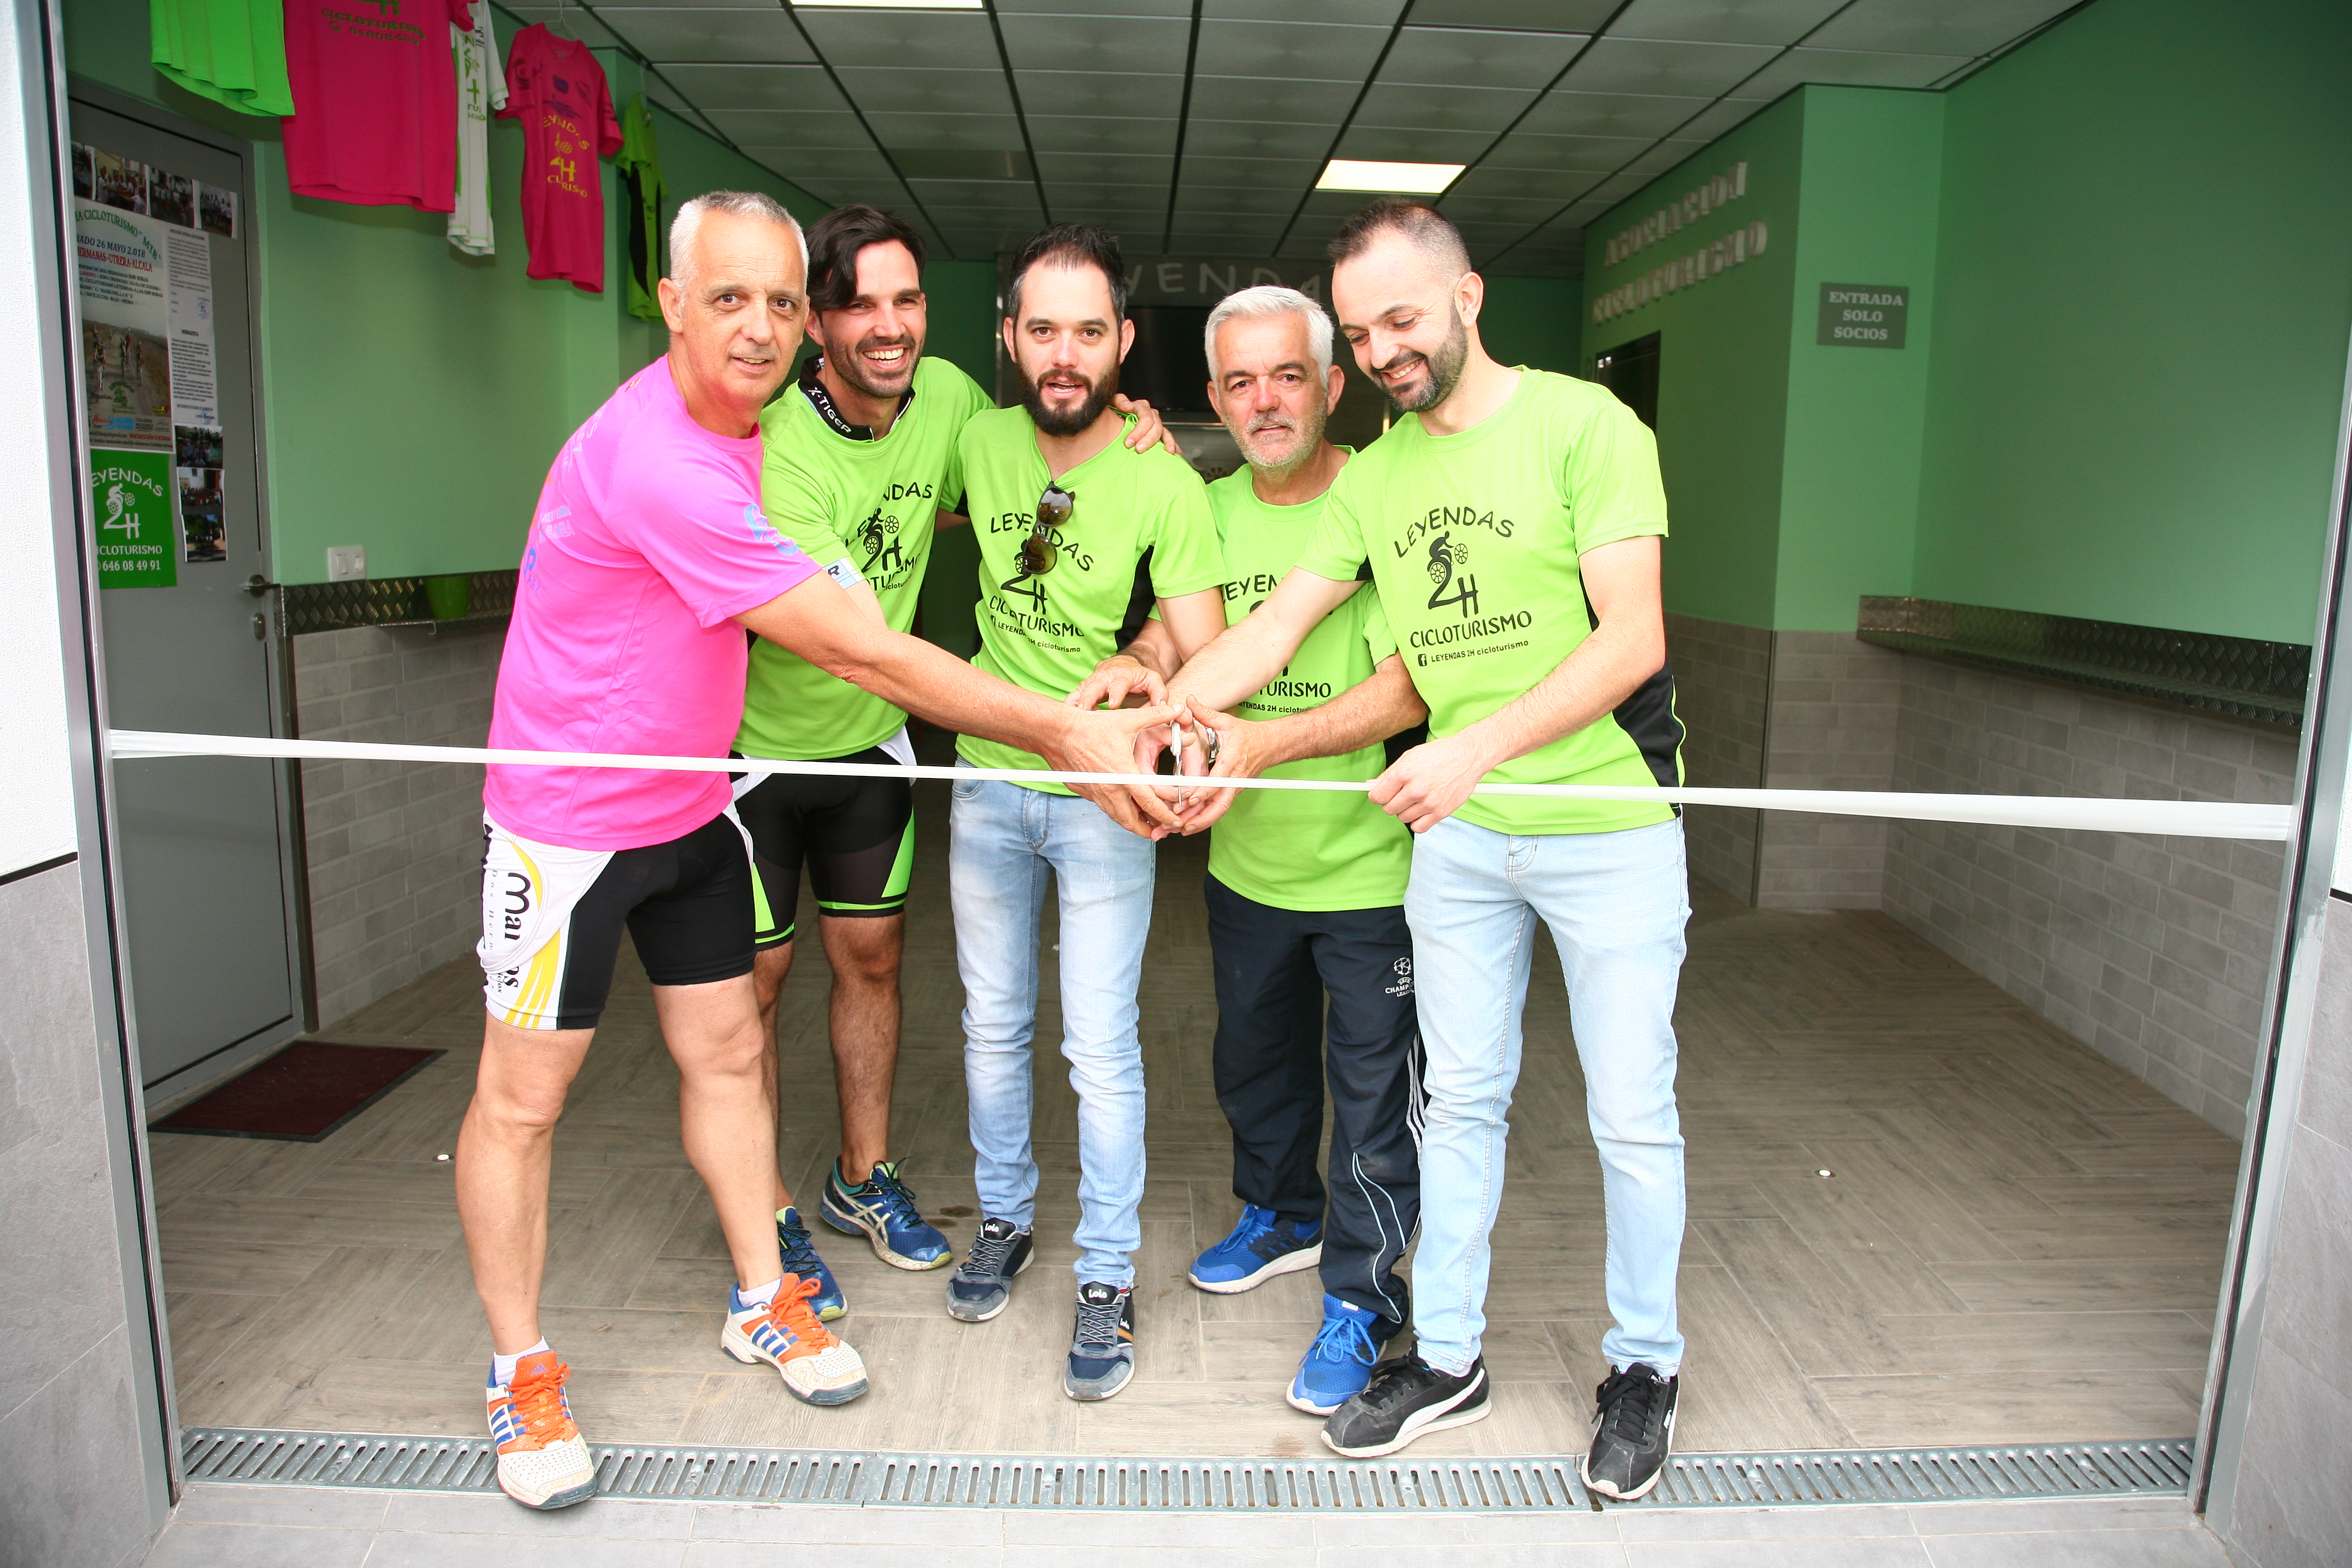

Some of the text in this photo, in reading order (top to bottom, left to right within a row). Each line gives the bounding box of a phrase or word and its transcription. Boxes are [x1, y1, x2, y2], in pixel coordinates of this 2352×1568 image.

[96, 239, 106, 248] 26
[107, 241, 126, 253] MAYO
[1829, 291, 1903, 306] ENTRADA
[1843, 309, 1884, 323] SOLO
[1833, 326, 1888, 340] SOCIOS
[1394, 506, 1515, 558] LEYENDAS
[102, 560, 161, 571] 646 08 49 91
[1410, 610, 1532, 648] CICLOTURISMO
[1037, 641, 1081, 653] cicloturismo
[1431, 650, 1466, 662] LEYENDAS
[1476, 639, 1529, 656] cicloturismo
[1267, 704, 1277, 712] 2H
